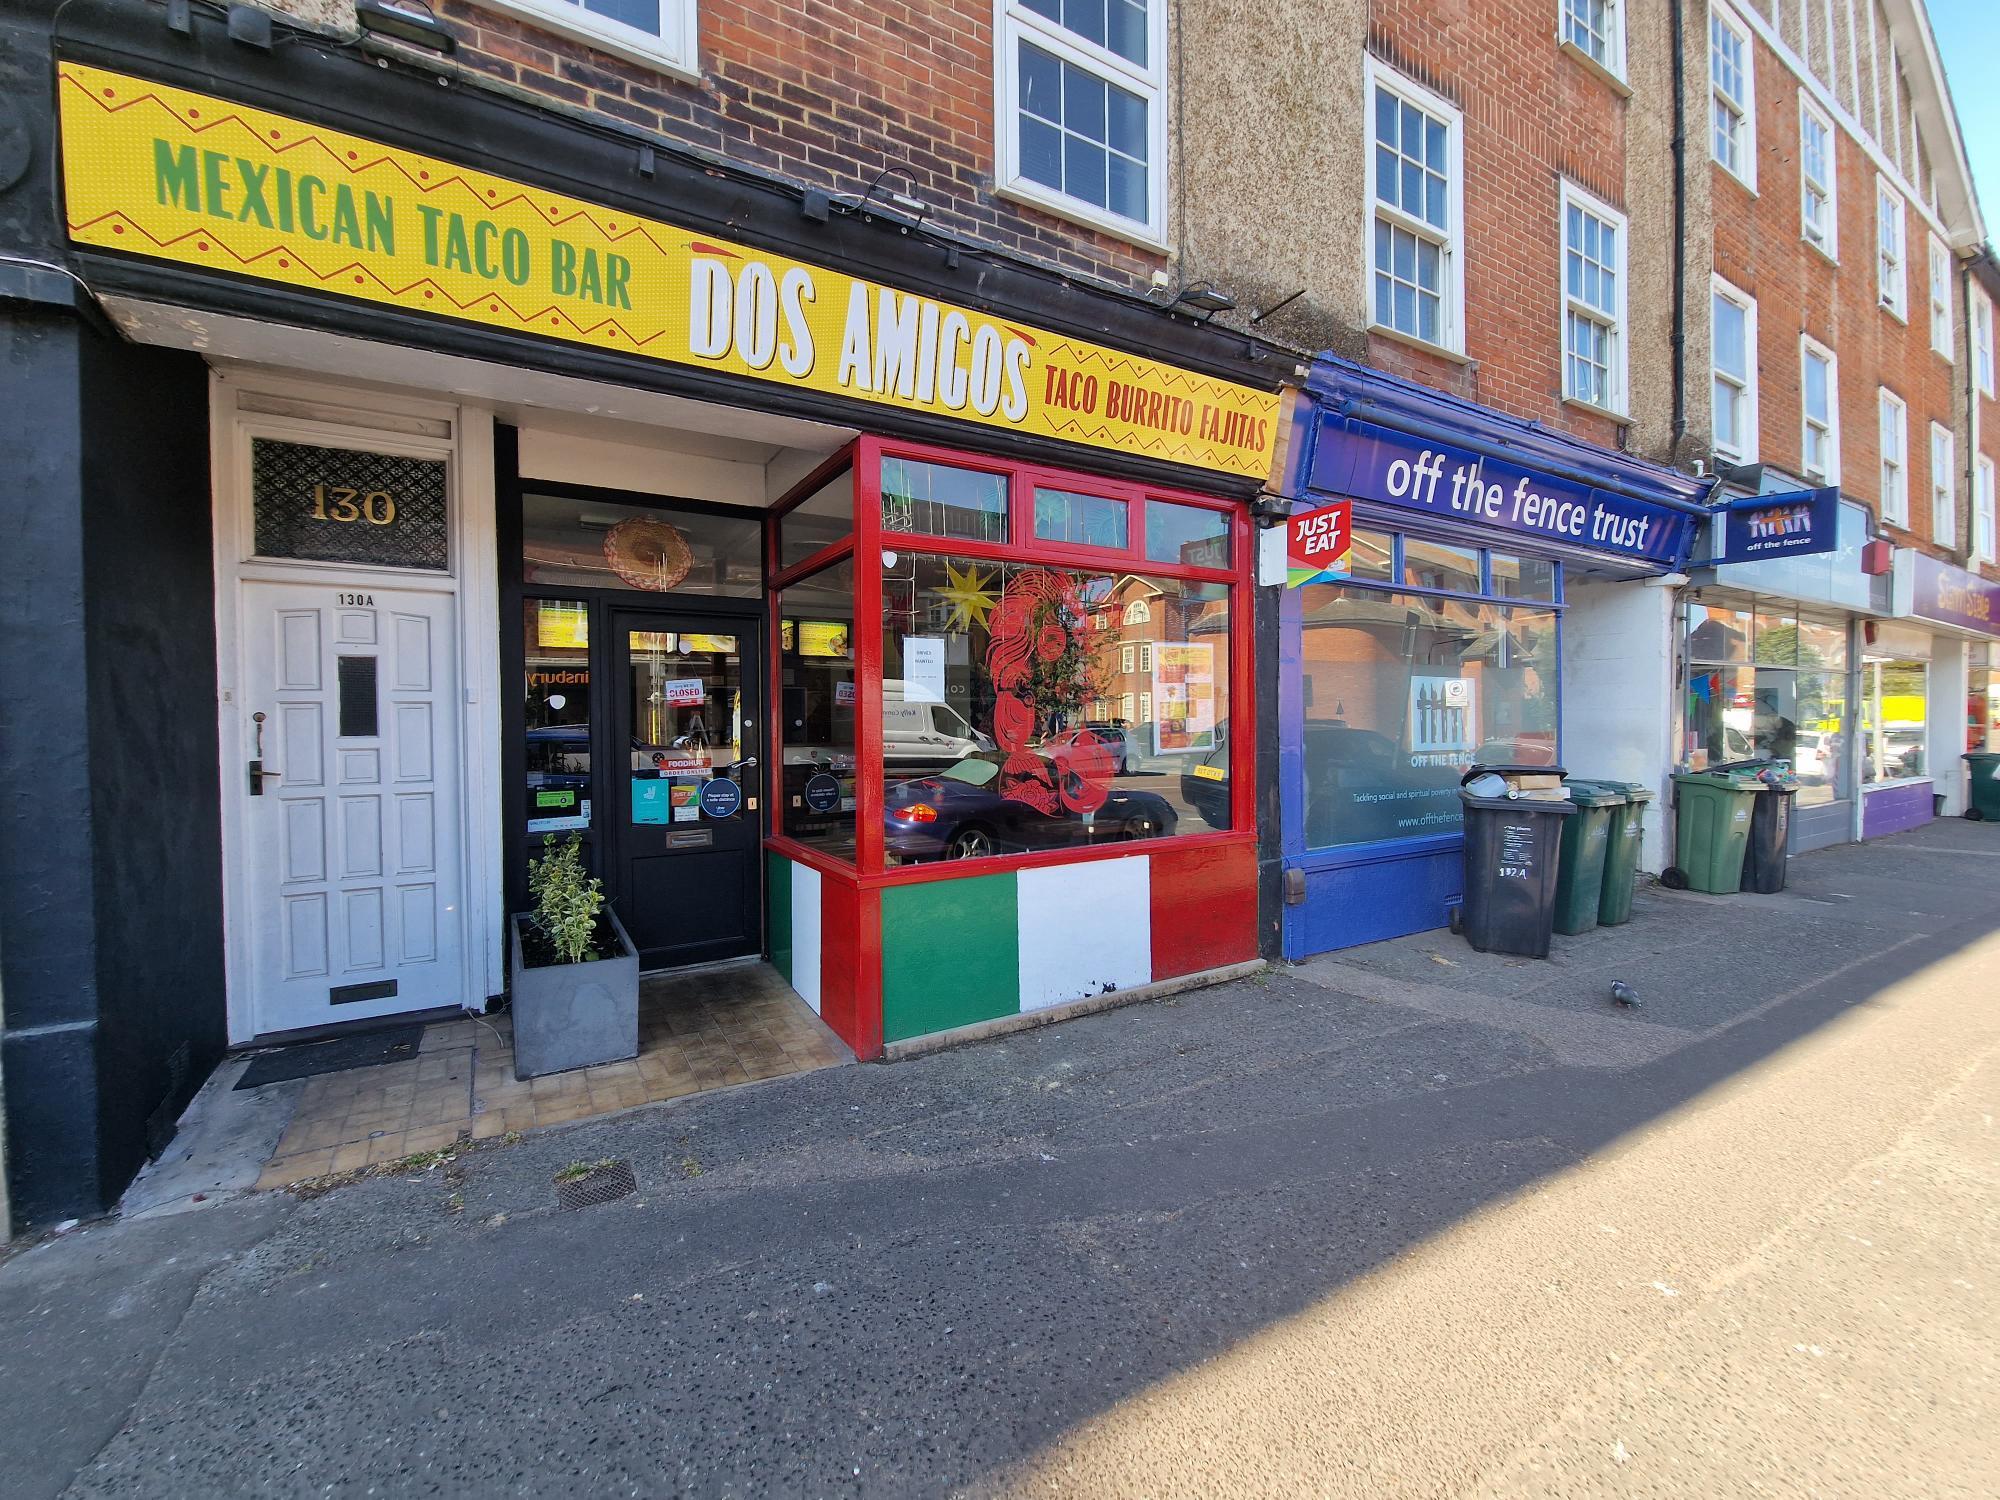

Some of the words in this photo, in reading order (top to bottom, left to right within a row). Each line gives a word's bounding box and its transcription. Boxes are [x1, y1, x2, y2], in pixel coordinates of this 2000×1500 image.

[153, 137, 396, 257] MEXICAN
[417, 203, 530, 287] TACO
[551, 239, 633, 311] BAR
[690, 258, 815, 378] DOS
[838, 282, 1031, 422] AMIGOS
[1045, 364, 1096, 415] TACO
[1106, 381, 1193, 436] BURRITO
[1200, 402, 1268, 453] FAJITAS
[312, 484, 396, 525] 130
[1386, 450, 1448, 503] off
[1451, 457, 1501, 518] the
[1512, 477, 1586, 537] fence
[1592, 503, 1649, 550] trust
[1295, 511, 1341, 541] JUST
[1305, 530, 1341, 555] EAT
[1746, 543, 1762, 551] off
[1764, 540, 1780, 549] the
[1783, 537, 1811, 547] fence
[339, 594, 374, 606] 130A
[669, 689, 699, 698] CLOSED
[668, 760, 703, 768] FOODHUB
[1411, 754, 1427, 767] OFF
[1429, 754, 1447, 767] THE
[1450, 753, 1476, 766] FENCE
[1353, 793, 1377, 803] Tackling
[1378, 792, 1395, 801] social
[1396, 791, 1407, 799] and
[1408, 789, 1430, 798] spiritual
[1431, 788, 1451, 798] poverty
